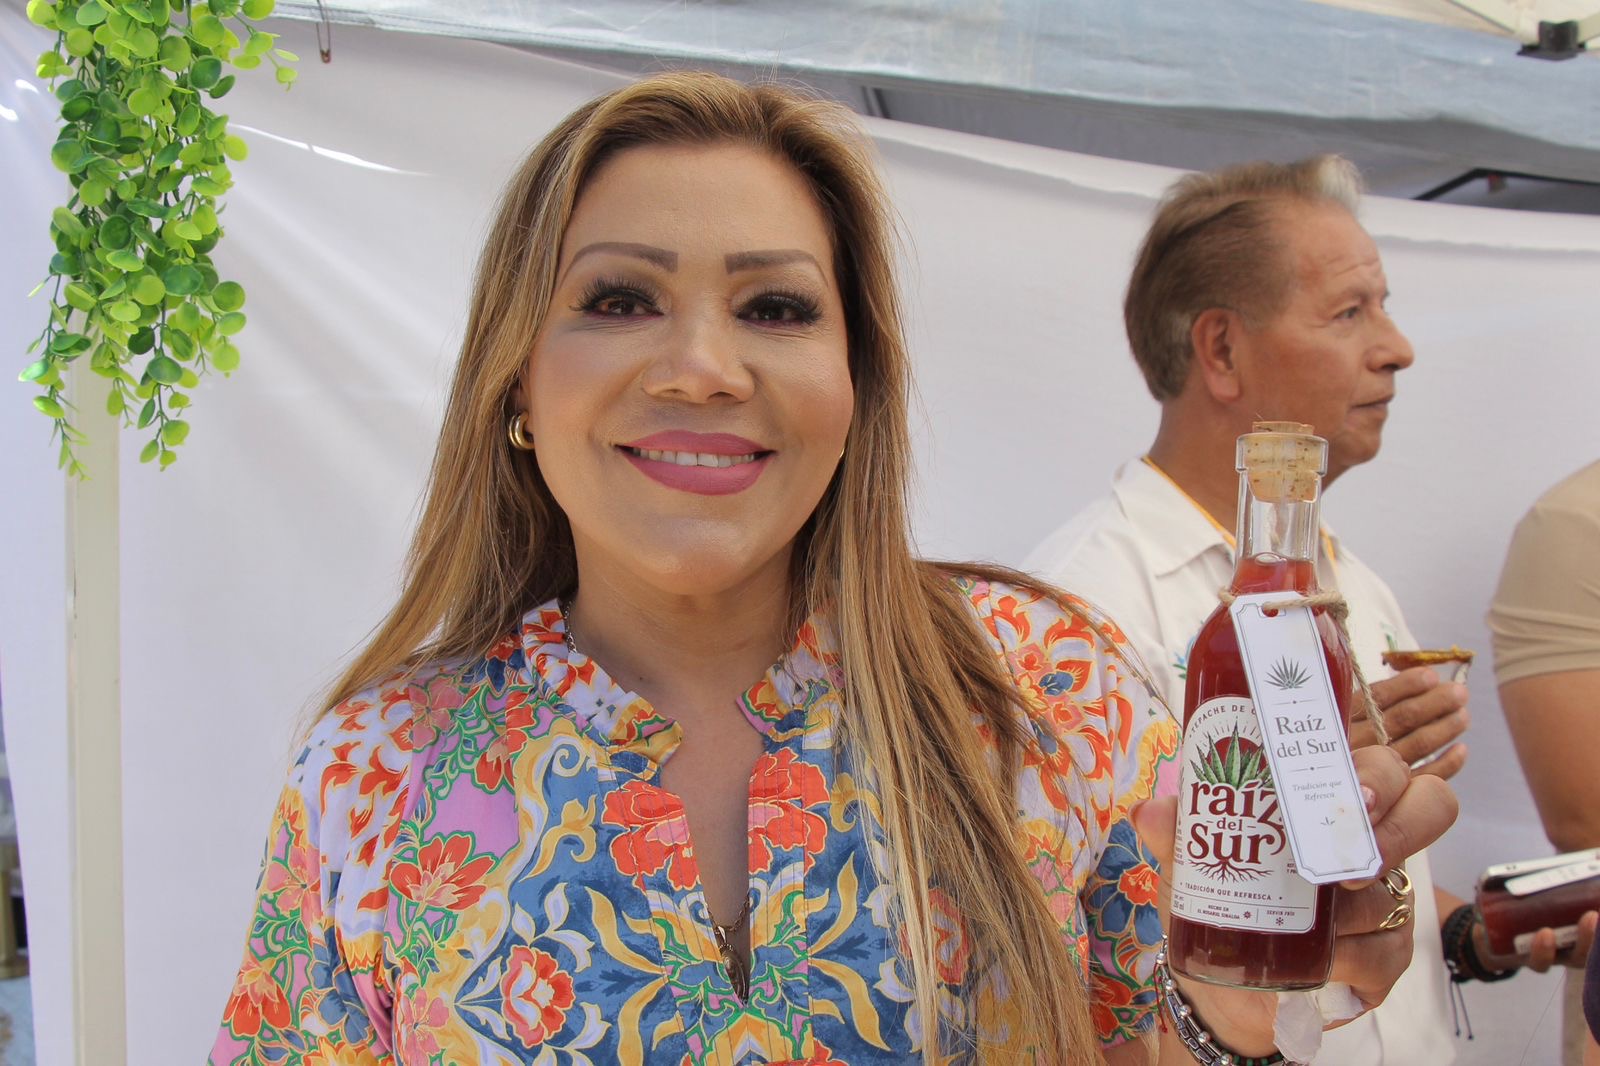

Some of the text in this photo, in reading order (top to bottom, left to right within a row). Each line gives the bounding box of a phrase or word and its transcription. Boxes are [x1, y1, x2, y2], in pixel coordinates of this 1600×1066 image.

[1191, 704, 1245, 733] TEPACHE DE
[1275, 714, 1326, 735] Raíz
[1276, 738, 1337, 759] del Sur
[1189, 781, 1286, 848] raíz
[1216, 817, 1243, 832] del
[1185, 882, 1272, 901] TRADICIÓN QUE REFRESCA
